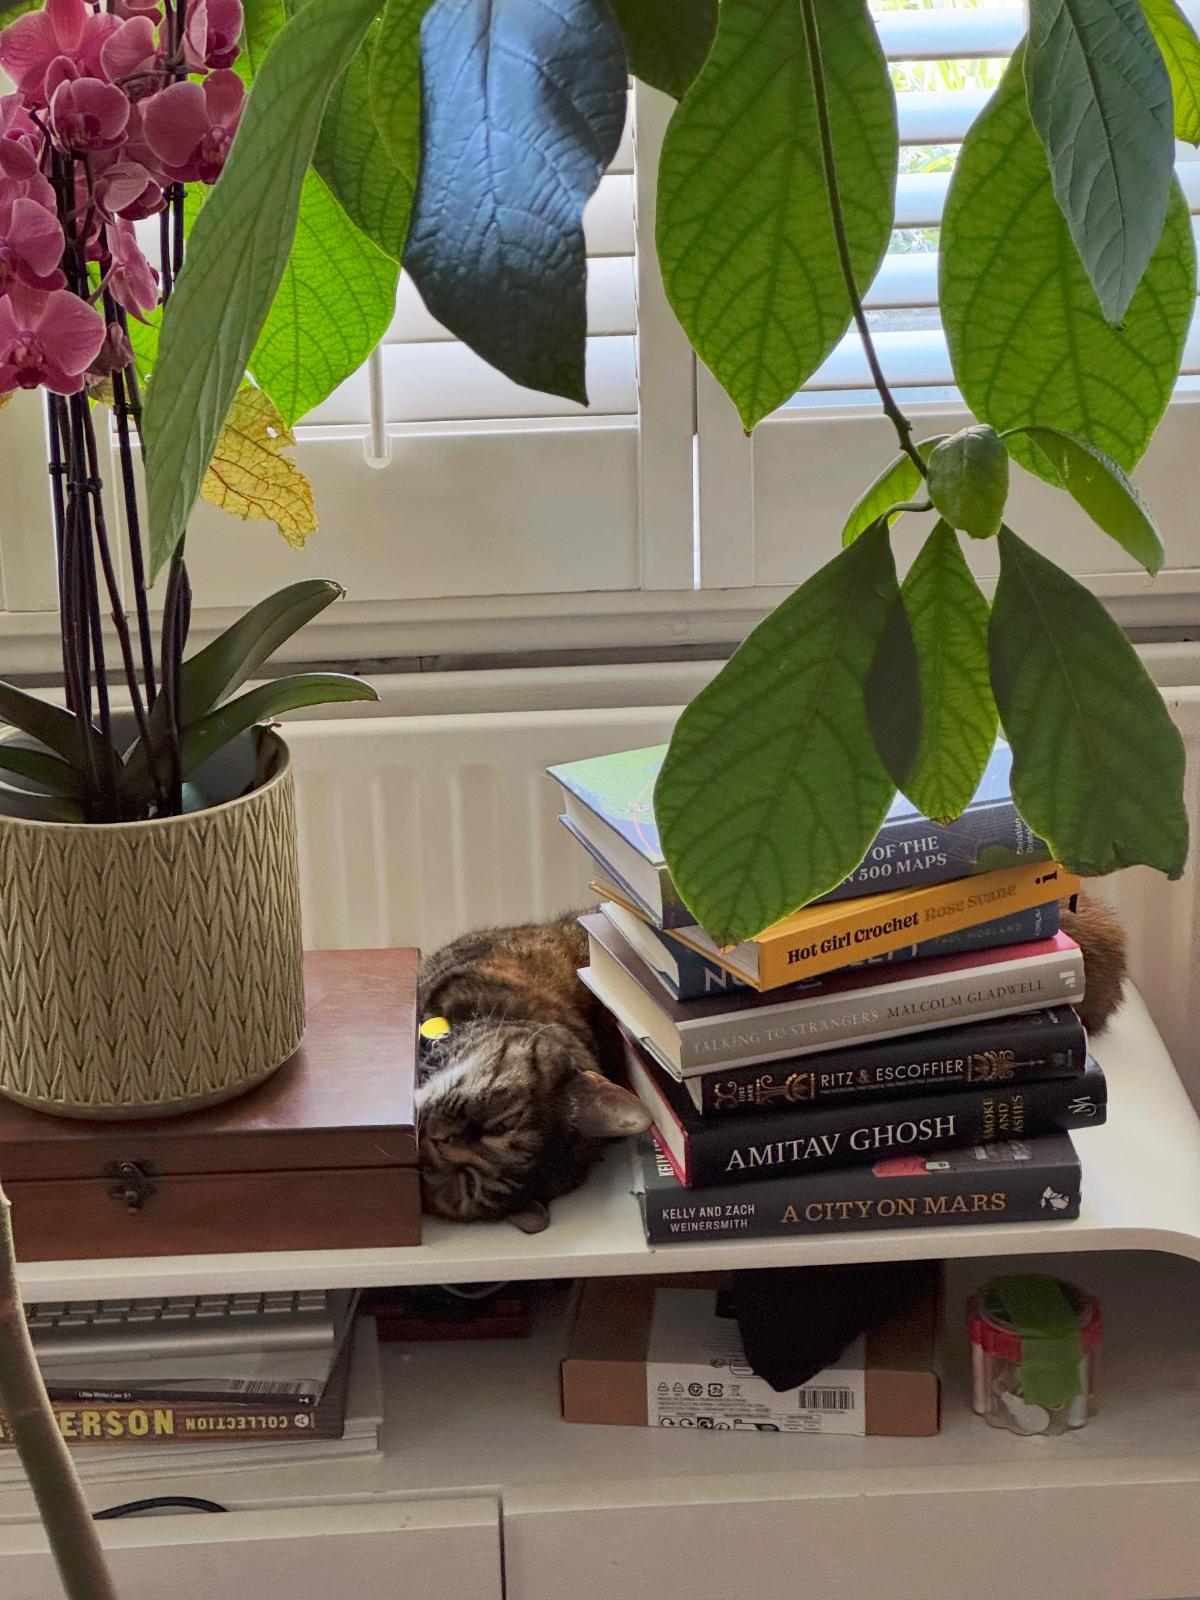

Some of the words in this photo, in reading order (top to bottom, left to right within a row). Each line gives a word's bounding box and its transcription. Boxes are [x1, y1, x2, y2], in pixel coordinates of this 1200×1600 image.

[872, 845, 896, 861] OF
[900, 836, 939, 854] THE
[859, 864, 892, 881] 500
[896, 852, 948, 874] MAPS
[787, 943, 818, 964] Hot
[820, 932, 851, 954] Girl
[854, 911, 920, 944] Crochet
[924, 900, 965, 922] Rose
[695, 1032, 760, 1054] TALKING
[767, 1028, 786, 1041] TO
[791, 1010, 880, 1034] STRANGERS
[887, 994, 962, 1019] MALCOLM
[967, 979, 1045, 1004] GLADWELL
[821, 1071, 853, 1087] RITZ
[857, 1069, 870, 1084] &
[876, 1059, 964, 1081] ESCOFFIER
[983, 1097, 995, 1140] SMOKE
[999, 1103, 1009, 1130] AND
[1011, 1095, 1025, 1133] ASHES
[725, 1133, 842, 1172] AMITAV
[849, 1114, 957, 1151] GHOSH
[662, 1207, 696, 1220] KELLY
[699, 1206, 721, 1218] AND
[725, 1204, 755, 1216] ZACH
[781, 1206, 799, 1223] A
[805, 1200, 873, 1221] CITY
[876, 1198, 917, 1217] ON
[924, 1193, 1007, 1214] MARS
[670, 1218, 748, 1233] WEINERSMITH
[185, 1415, 288, 1430] COLLECTION
